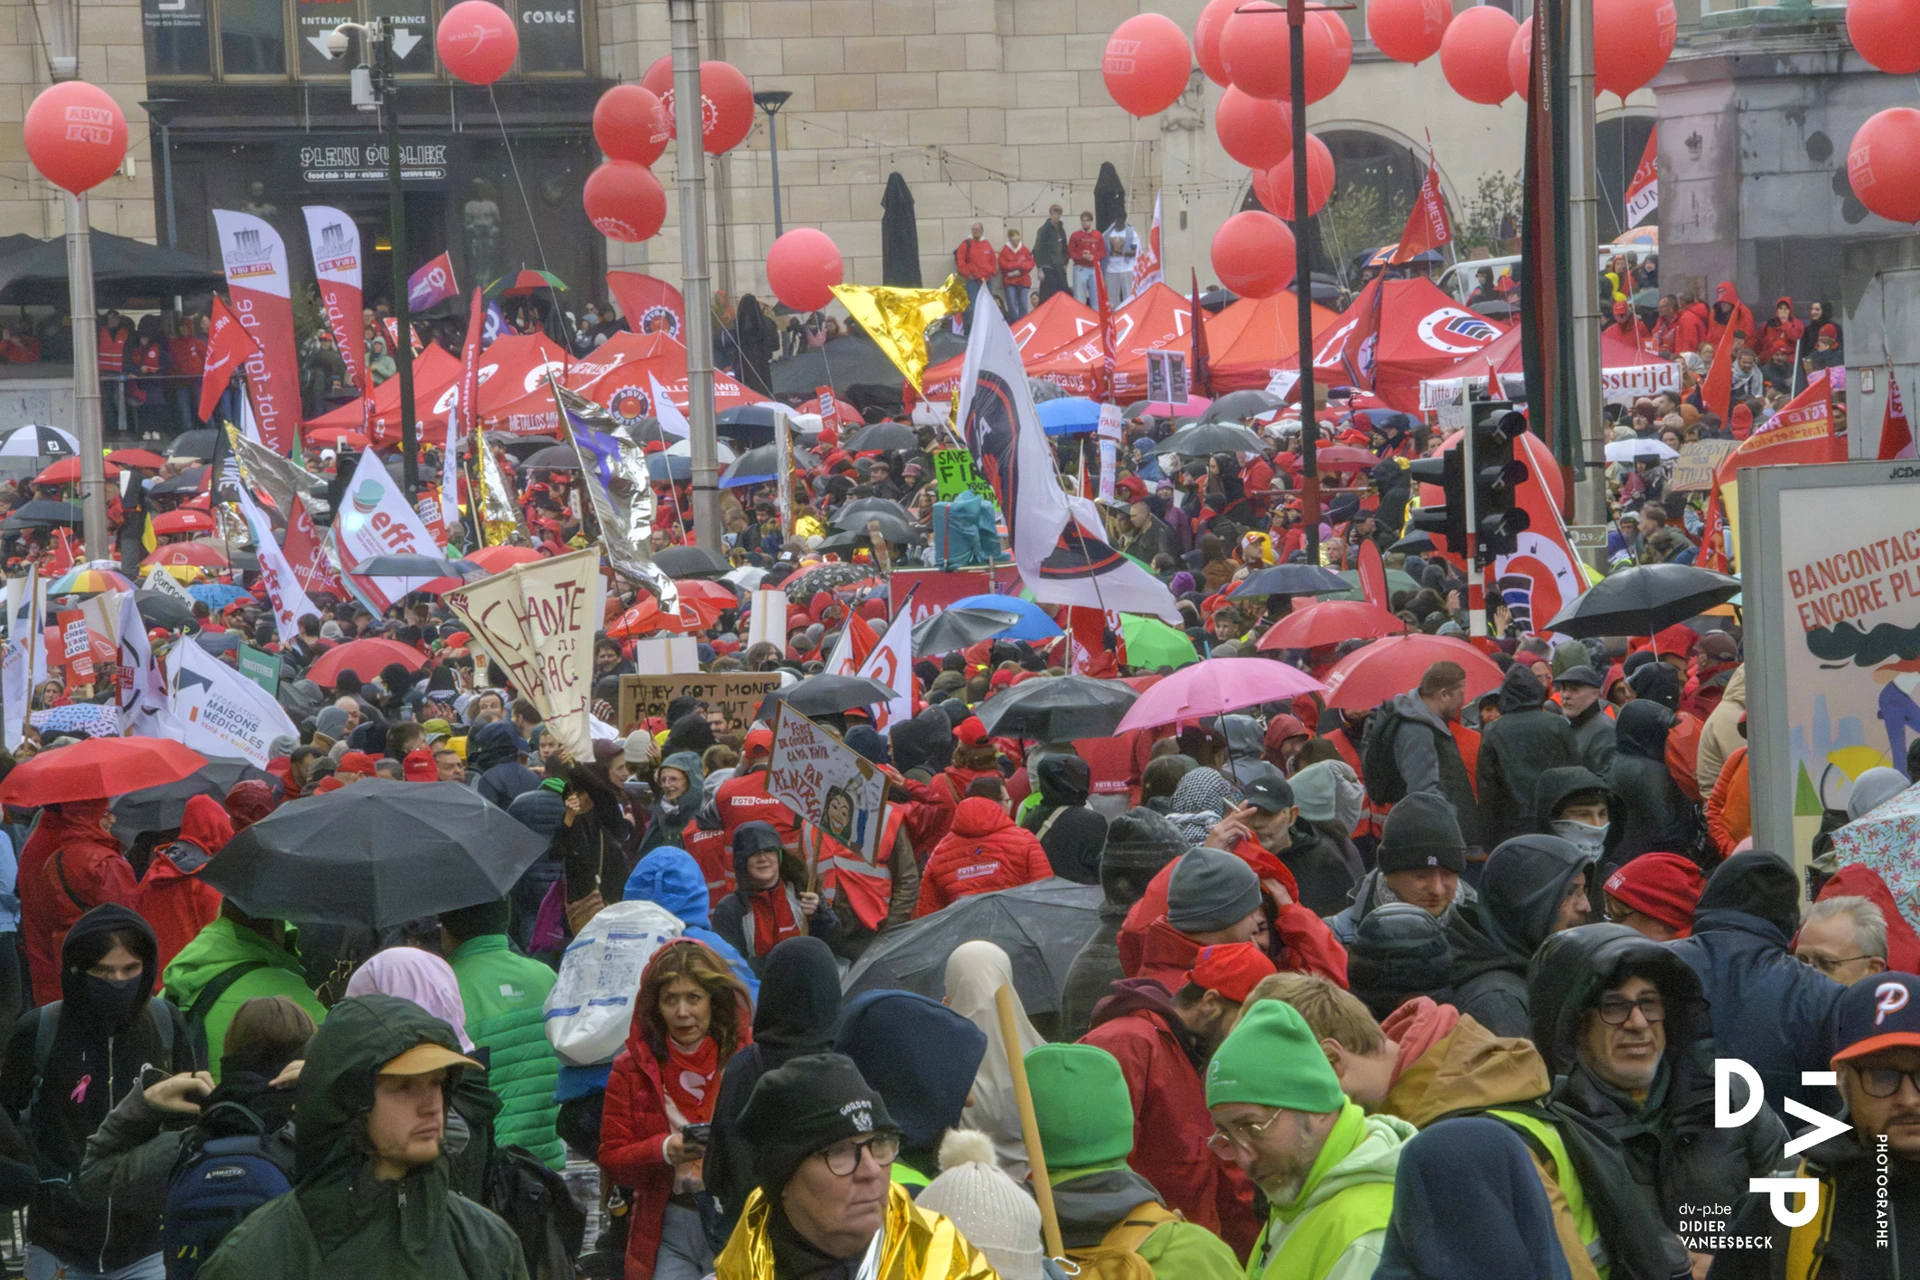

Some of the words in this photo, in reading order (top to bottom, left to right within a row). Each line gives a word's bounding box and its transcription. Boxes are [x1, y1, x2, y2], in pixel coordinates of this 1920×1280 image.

[375, 15, 426, 25] ETRANCE
[67, 107, 111, 124] ABVV
[937, 450, 969, 465] SAVE
[1787, 527, 1920, 600] BANCONTAC
[1796, 577, 1889, 633] ENCORE
[1888, 564, 1920, 603] PL
[480, 579, 586, 652] CHANTE
[627, 684, 674, 700] THEY
[681, 684, 717, 697] GOT
[725, 681, 780, 697] MONEY
[206, 699, 260, 733] MAISONS
[635, 702, 667, 721] FOR
[202, 709, 265, 750] MÉDICALES
[803, 762, 824, 790] PAR
[732, 796, 755, 806] FGTB
[755, 797, 780, 805] Centre
[1874, 982, 1909, 1027] P
[839, 1099, 873, 1117] GORDON
